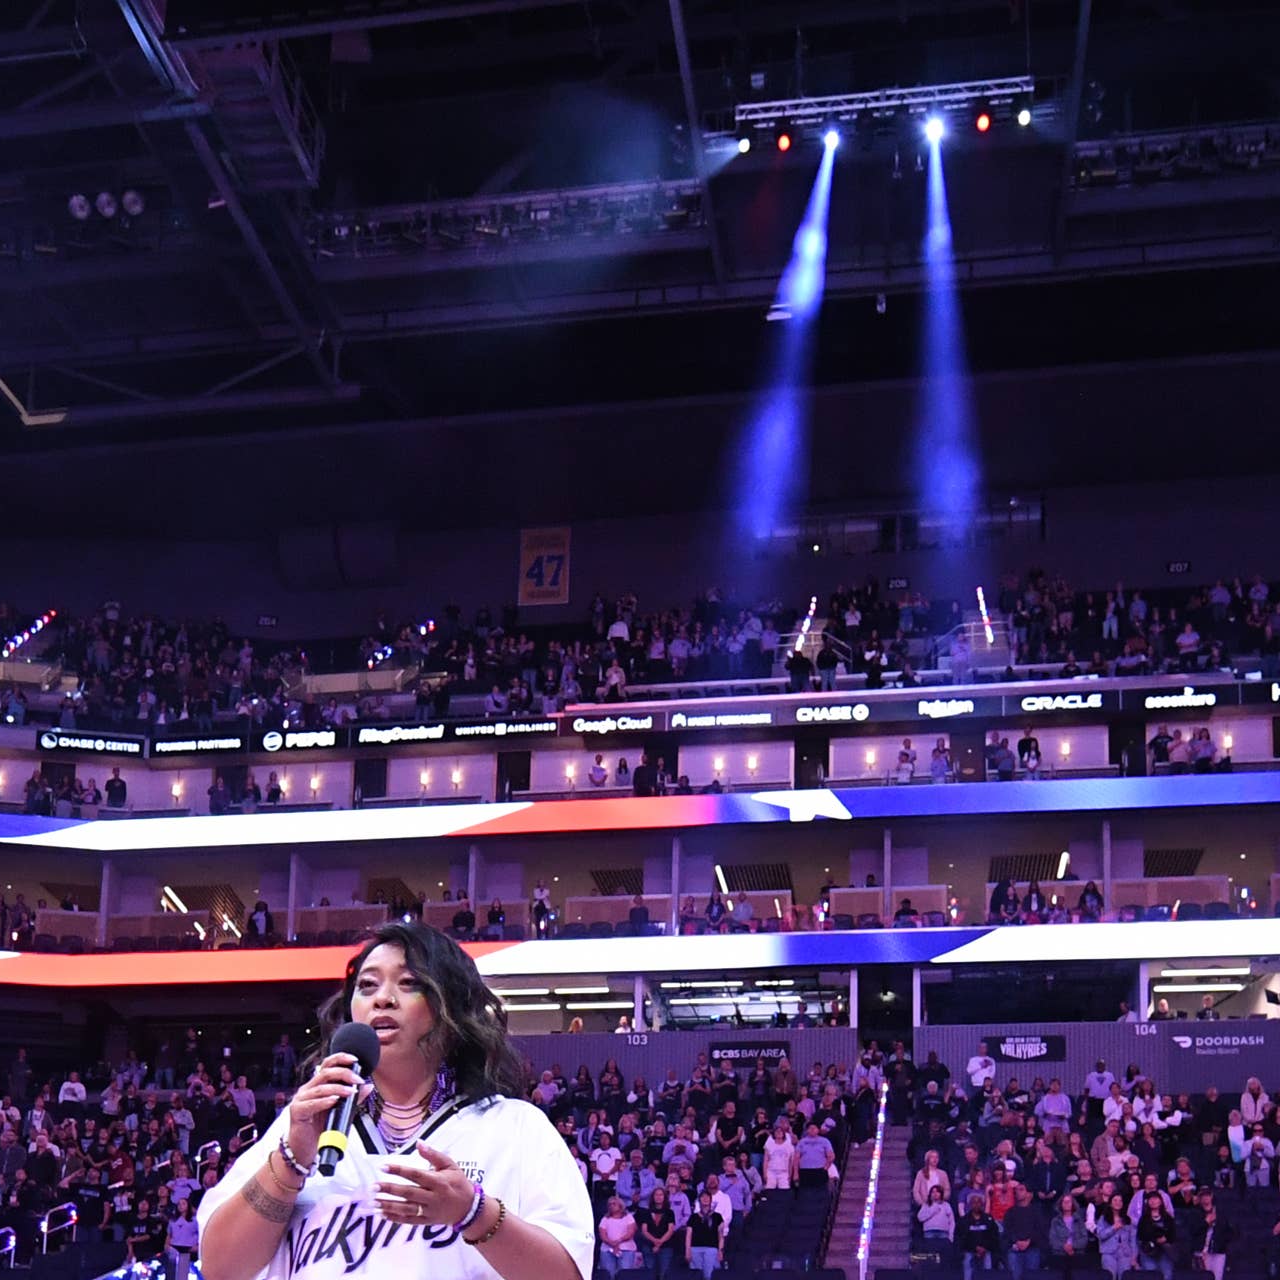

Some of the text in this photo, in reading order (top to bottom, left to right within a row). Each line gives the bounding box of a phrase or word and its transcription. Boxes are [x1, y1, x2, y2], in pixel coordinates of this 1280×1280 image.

[526, 554, 564, 588] 47
[1021, 694, 1102, 711] ORACLE
[796, 706, 852, 722] CHASE
[455, 722, 557, 736] UNITED AIRLINES
[573, 716, 652, 734] Google Cloud
[59, 737, 140, 752] CHASE CENTER
[285, 731, 336, 748] PEPSI
[1134, 1023, 1157, 1036] 104
[627, 1034, 648, 1045] 103
[1195, 1035, 1264, 1047] DOORDASH
[721, 1048, 787, 1059] CBS BAY AREA
[1000, 1042, 1047, 1060] VALKYRIES
